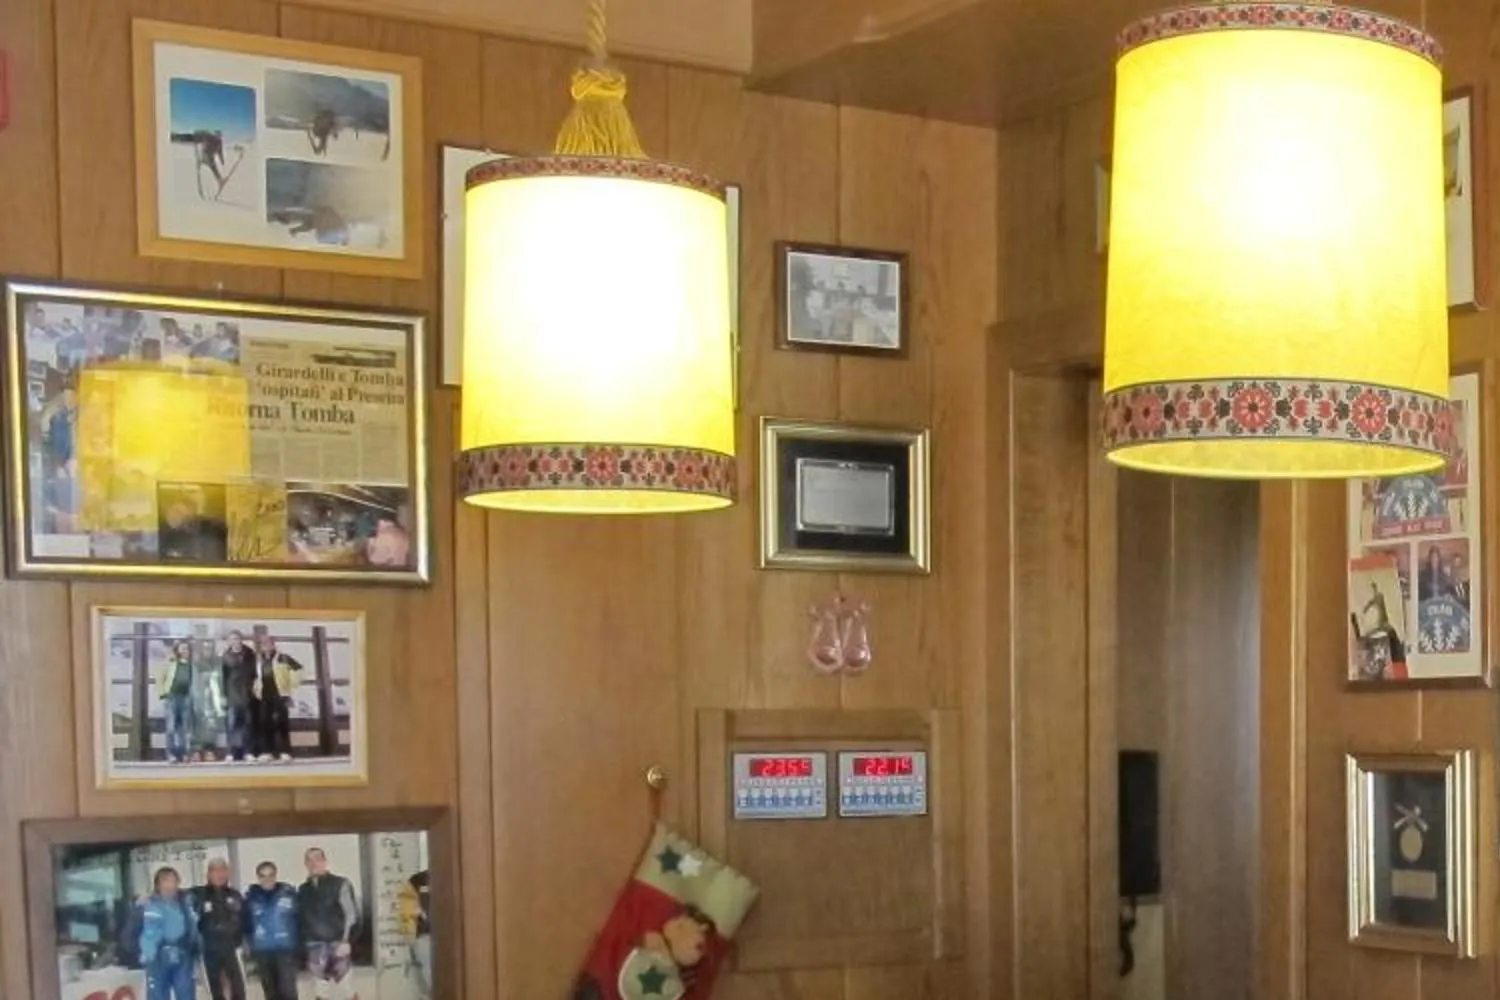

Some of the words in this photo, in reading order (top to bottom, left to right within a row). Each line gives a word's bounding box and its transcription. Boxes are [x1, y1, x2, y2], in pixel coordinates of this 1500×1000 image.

[255, 361, 336, 382] Girardelli
[352, 369, 405, 387] Tomba
[290, 400, 356, 425] Tomba
